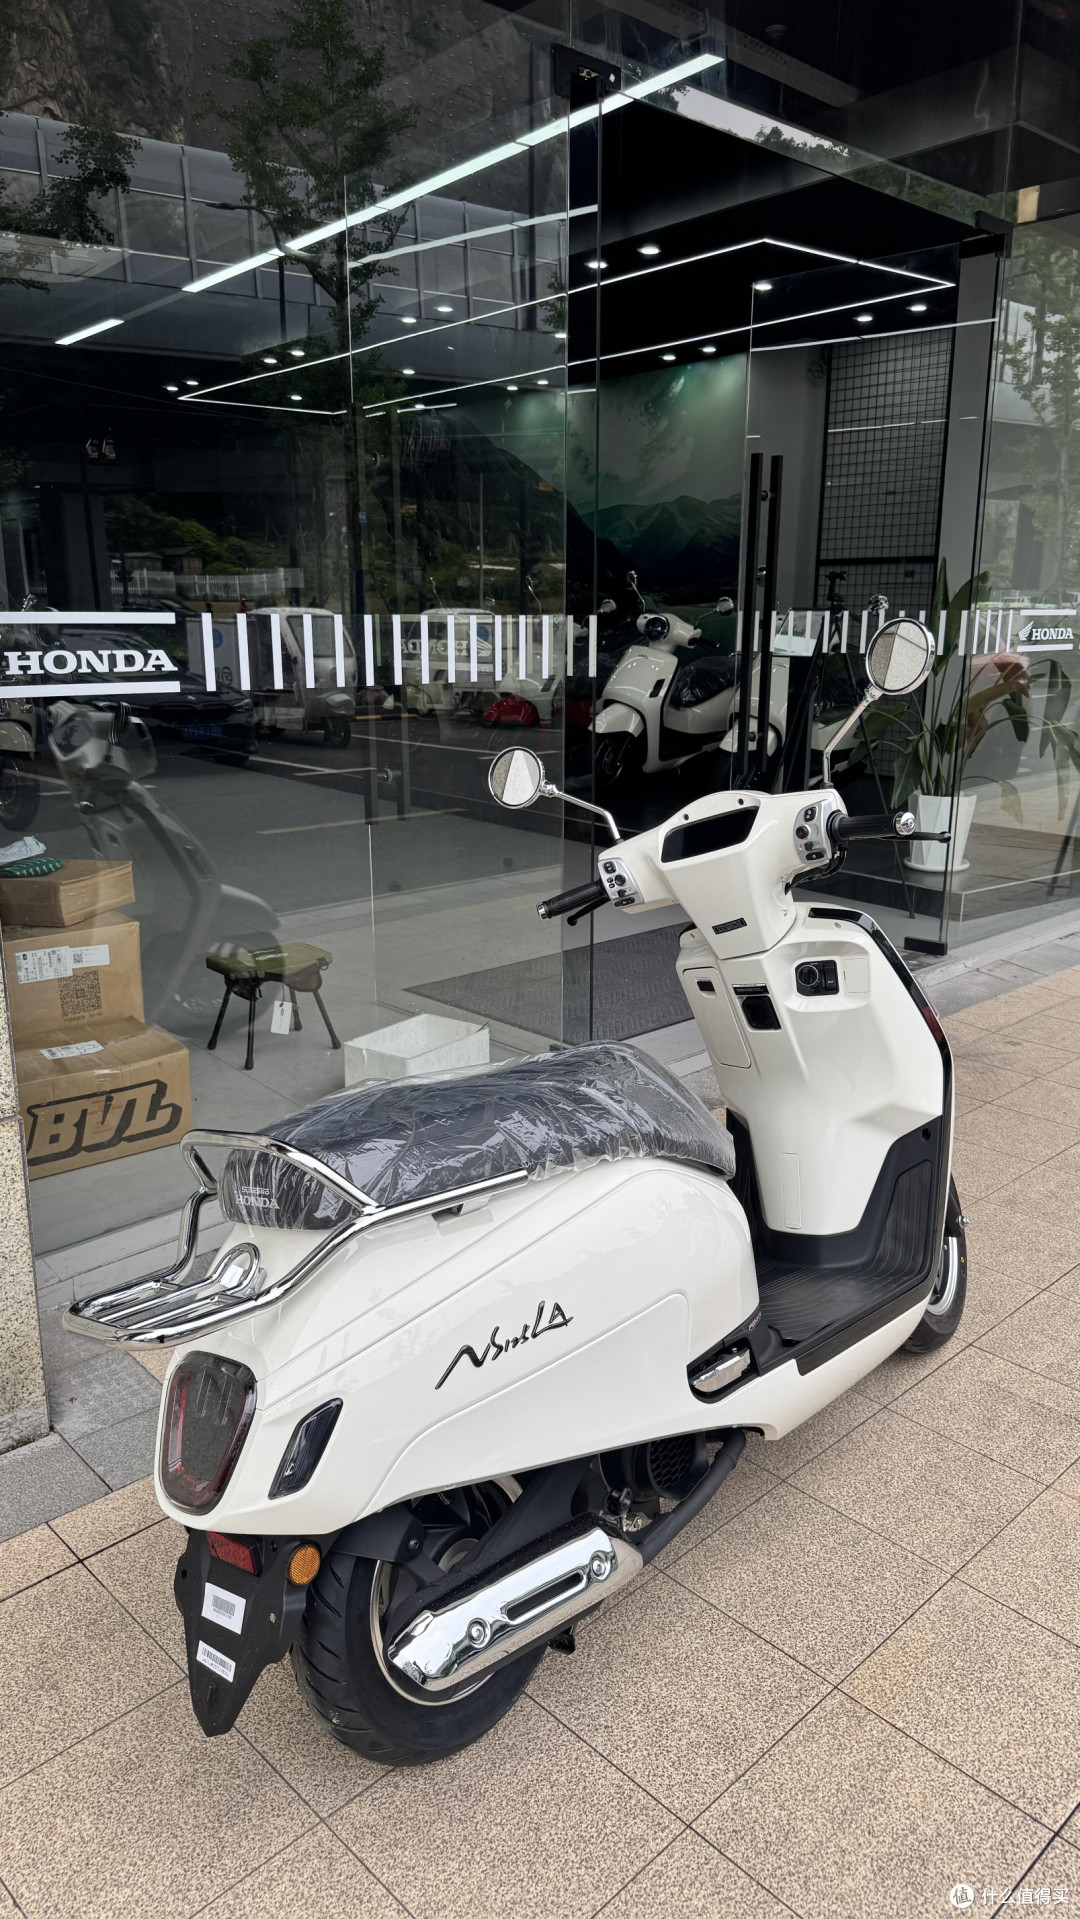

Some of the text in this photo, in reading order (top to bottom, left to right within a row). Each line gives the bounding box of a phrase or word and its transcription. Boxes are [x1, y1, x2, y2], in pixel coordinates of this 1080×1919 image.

[1031, 627, 1074, 641] HONDA
[3, 650, 179, 675] HONDA
[26, 1079, 182, 1167] BVL
[235, 1195, 280, 1210] HONDA
